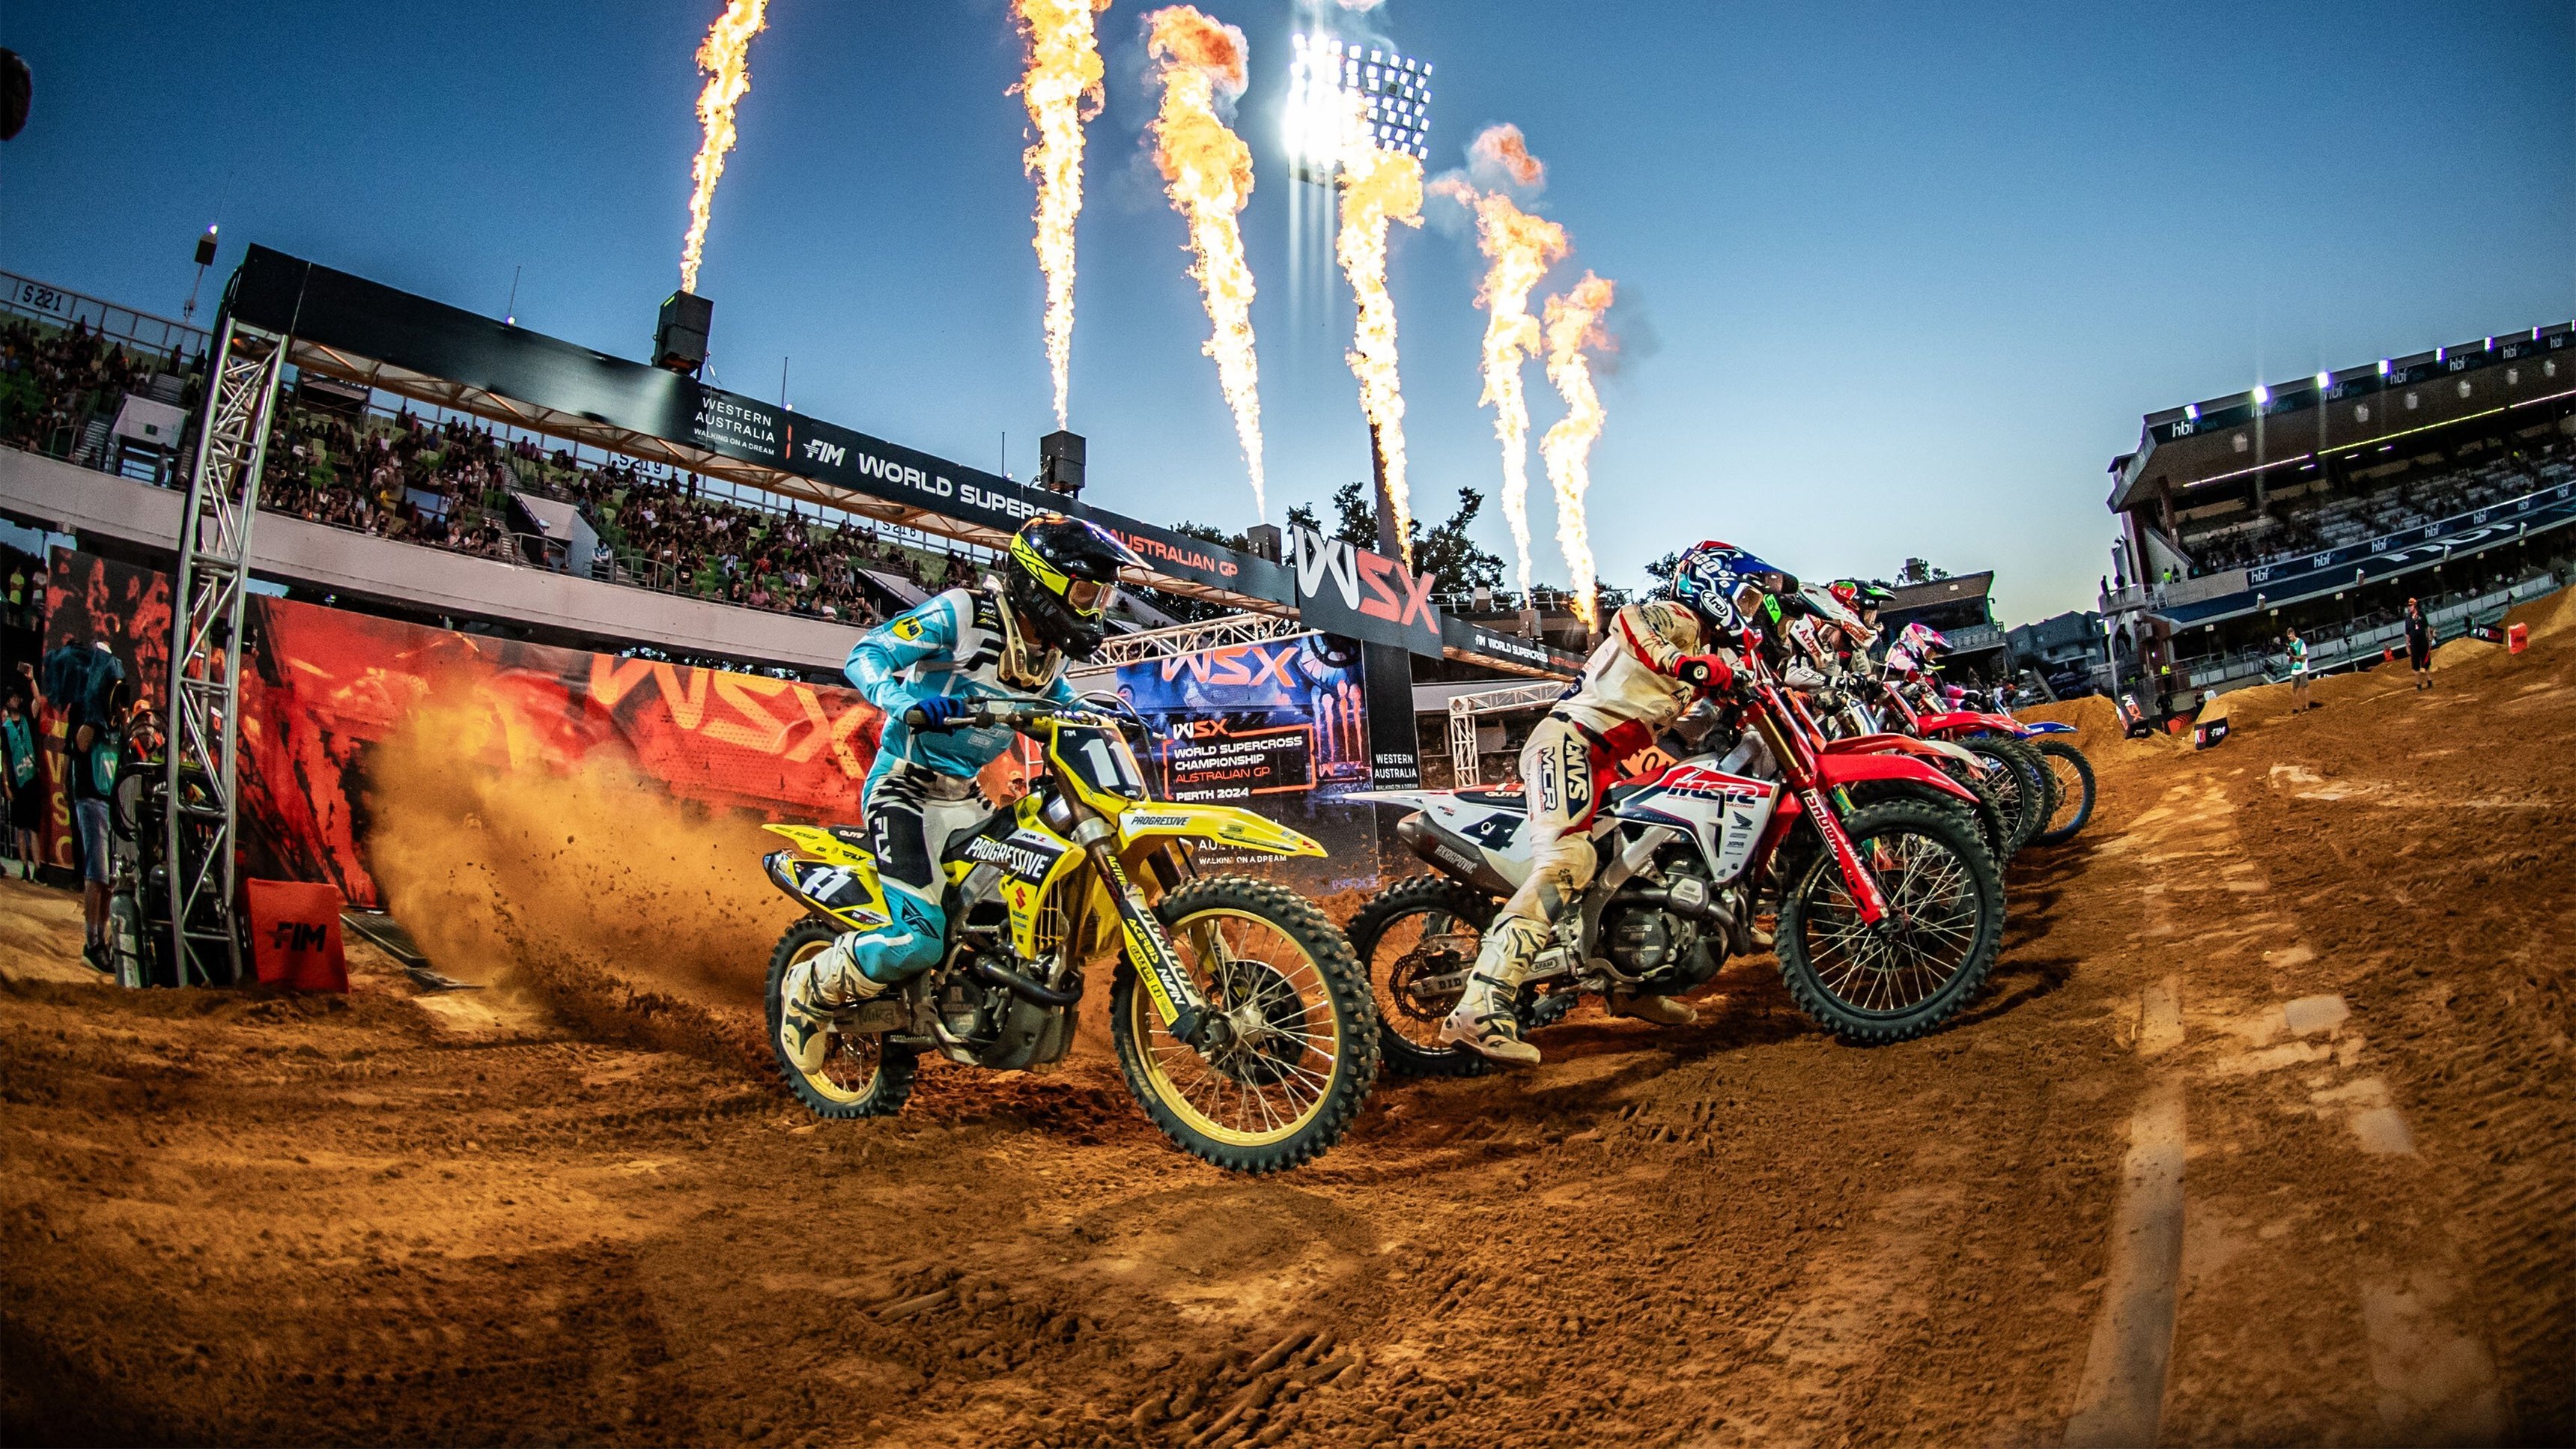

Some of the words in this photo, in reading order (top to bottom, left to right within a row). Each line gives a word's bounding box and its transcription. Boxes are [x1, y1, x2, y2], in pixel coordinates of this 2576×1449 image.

[702, 397, 772, 428] WESTERN
[695, 411, 776, 444] AUSTRALIA
[693, 428, 729, 443] WALKING
[729, 437, 741, 447] ON
[741, 441, 748, 449] A
[748, 443, 775, 456] DREAM
[803, 438, 846, 467] FIM
[859, 452, 953, 498] WORLD
[1218, 561, 1239, 577] GP
[2314, 553, 2333, 568] hbf
[1292, 523, 1440, 635] WSX
[2251, 565, 2272, 583] hbf
[1703, 592, 1728, 616] Arai
[1487, 637, 1512, 654] WORLD
[1512, 644, 1549, 663] SUPERCROSS
[1173, 718, 1230, 740] WSX
[1174, 745, 1217, 759] WORLD
[1220, 735, 1303, 754] SUPERCROSS
[1376, 753, 1414, 765] WESTERN
[1080, 738, 1141, 787] 11
[1175, 753, 1265, 771] CHAMPIONSHIP
[1374, 768, 1418, 779] AUSTRALIA
[1176, 768, 1251, 784] AUSTRALIAN
[1254, 766, 1270, 777] GP
[1541, 747, 1558, 811] MCR
[1176, 790, 1214, 802] PERTH
[1217, 787, 1250, 799] 2024
[1665, 795, 1718, 805] MOTOCONCEP
[1131, 816, 1189, 826] PROGRESSIVE
[839, 829, 866, 839] GUTS
[874, 815, 893, 864] FLY
[842, 849, 867, 861] FLY
[964, 836, 1049, 878] PROGRESSIVE
[1257, 854, 1287, 863] DREAM
[801, 866, 852, 902] 11
[267, 921, 326, 953] FIM
[1126, 918, 1159, 964] ACERBIS
[1137, 908, 1202, 999] DUNLOP
[1439, 977, 1462, 988] DID
